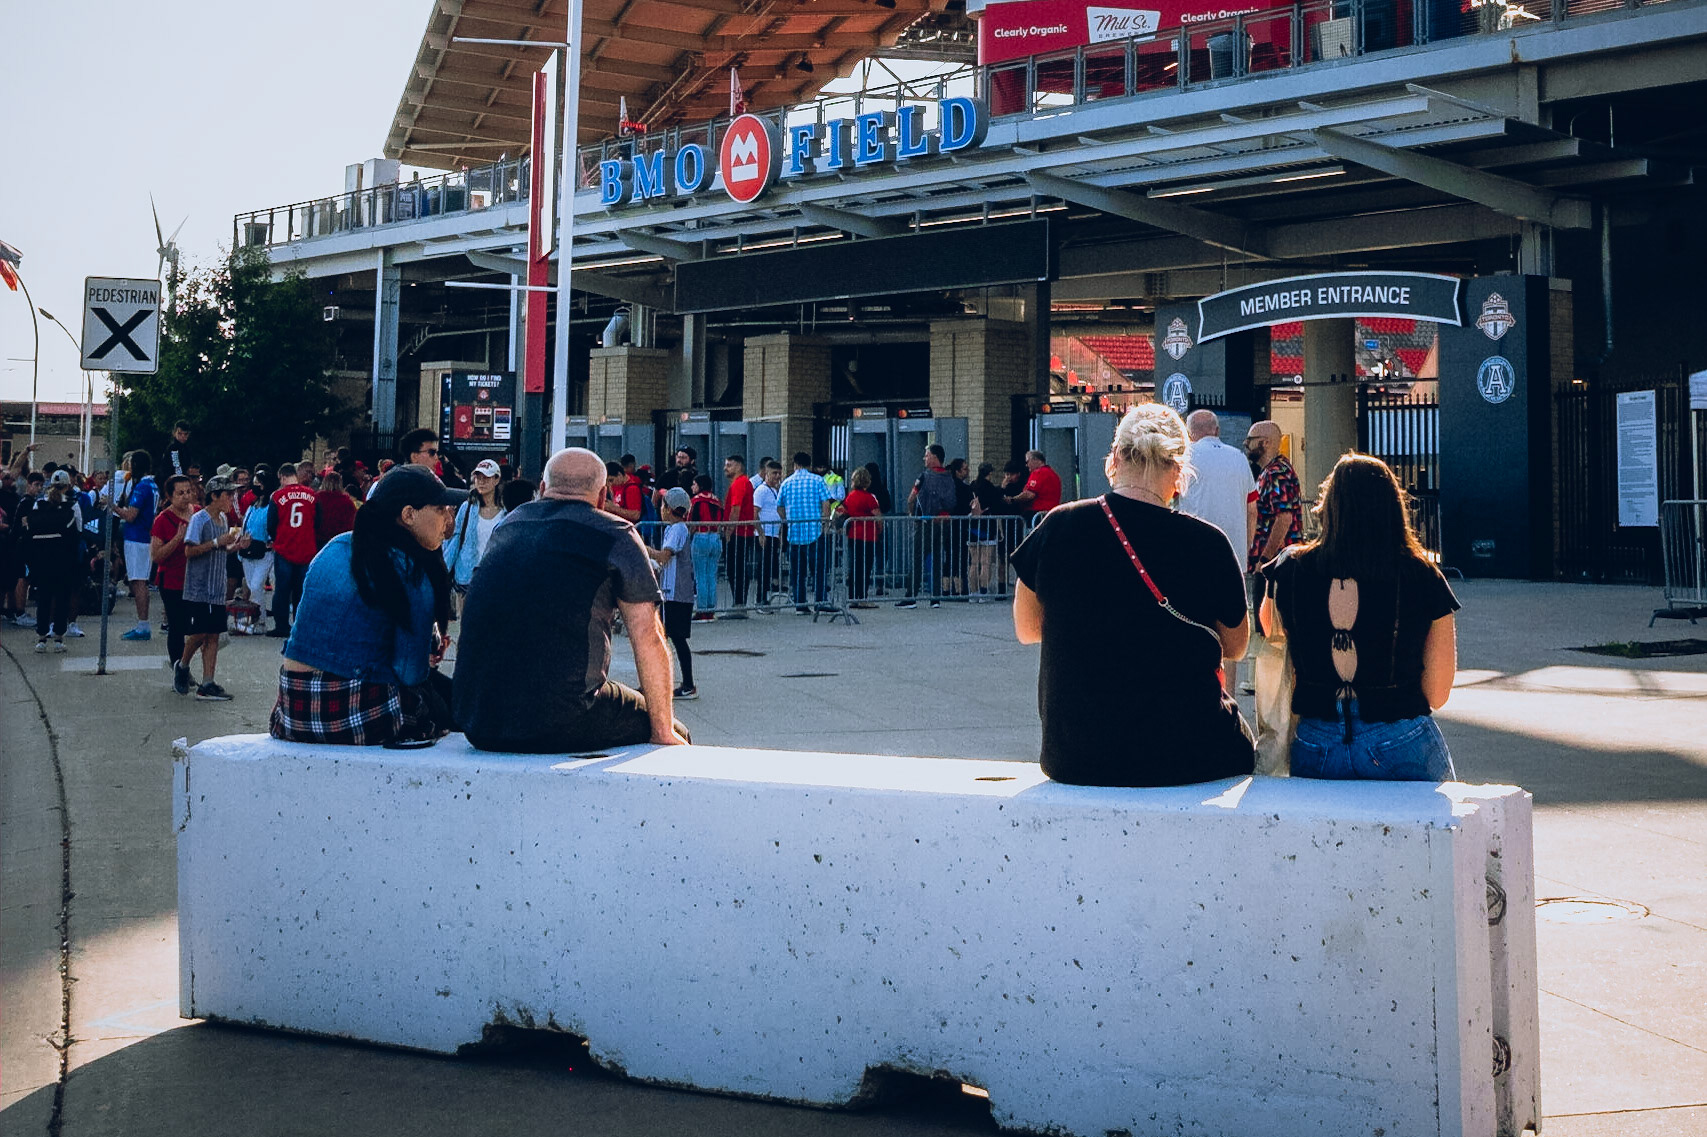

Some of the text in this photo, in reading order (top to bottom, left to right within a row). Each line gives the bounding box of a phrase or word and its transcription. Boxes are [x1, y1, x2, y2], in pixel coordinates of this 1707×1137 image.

[1093, 14, 1151, 32] Mill St.
[1180, 11, 1217, 23] Clearly
[994, 23, 1068, 38] Clearly Organic
[600, 96, 981, 206] BMO FIELD
[88, 287, 157, 305] PEDESTRIAN
[1240, 285, 1411, 316] MEMBER ENTRANCE
[1481, 313, 1512, 323] TORONTO
[86, 307, 155, 362] X
[1485, 364, 1508, 395] A
[1167, 380, 1187, 406] A
[278, 491, 315, 506] DE GUZMAN
[290, 502, 304, 528] 6
